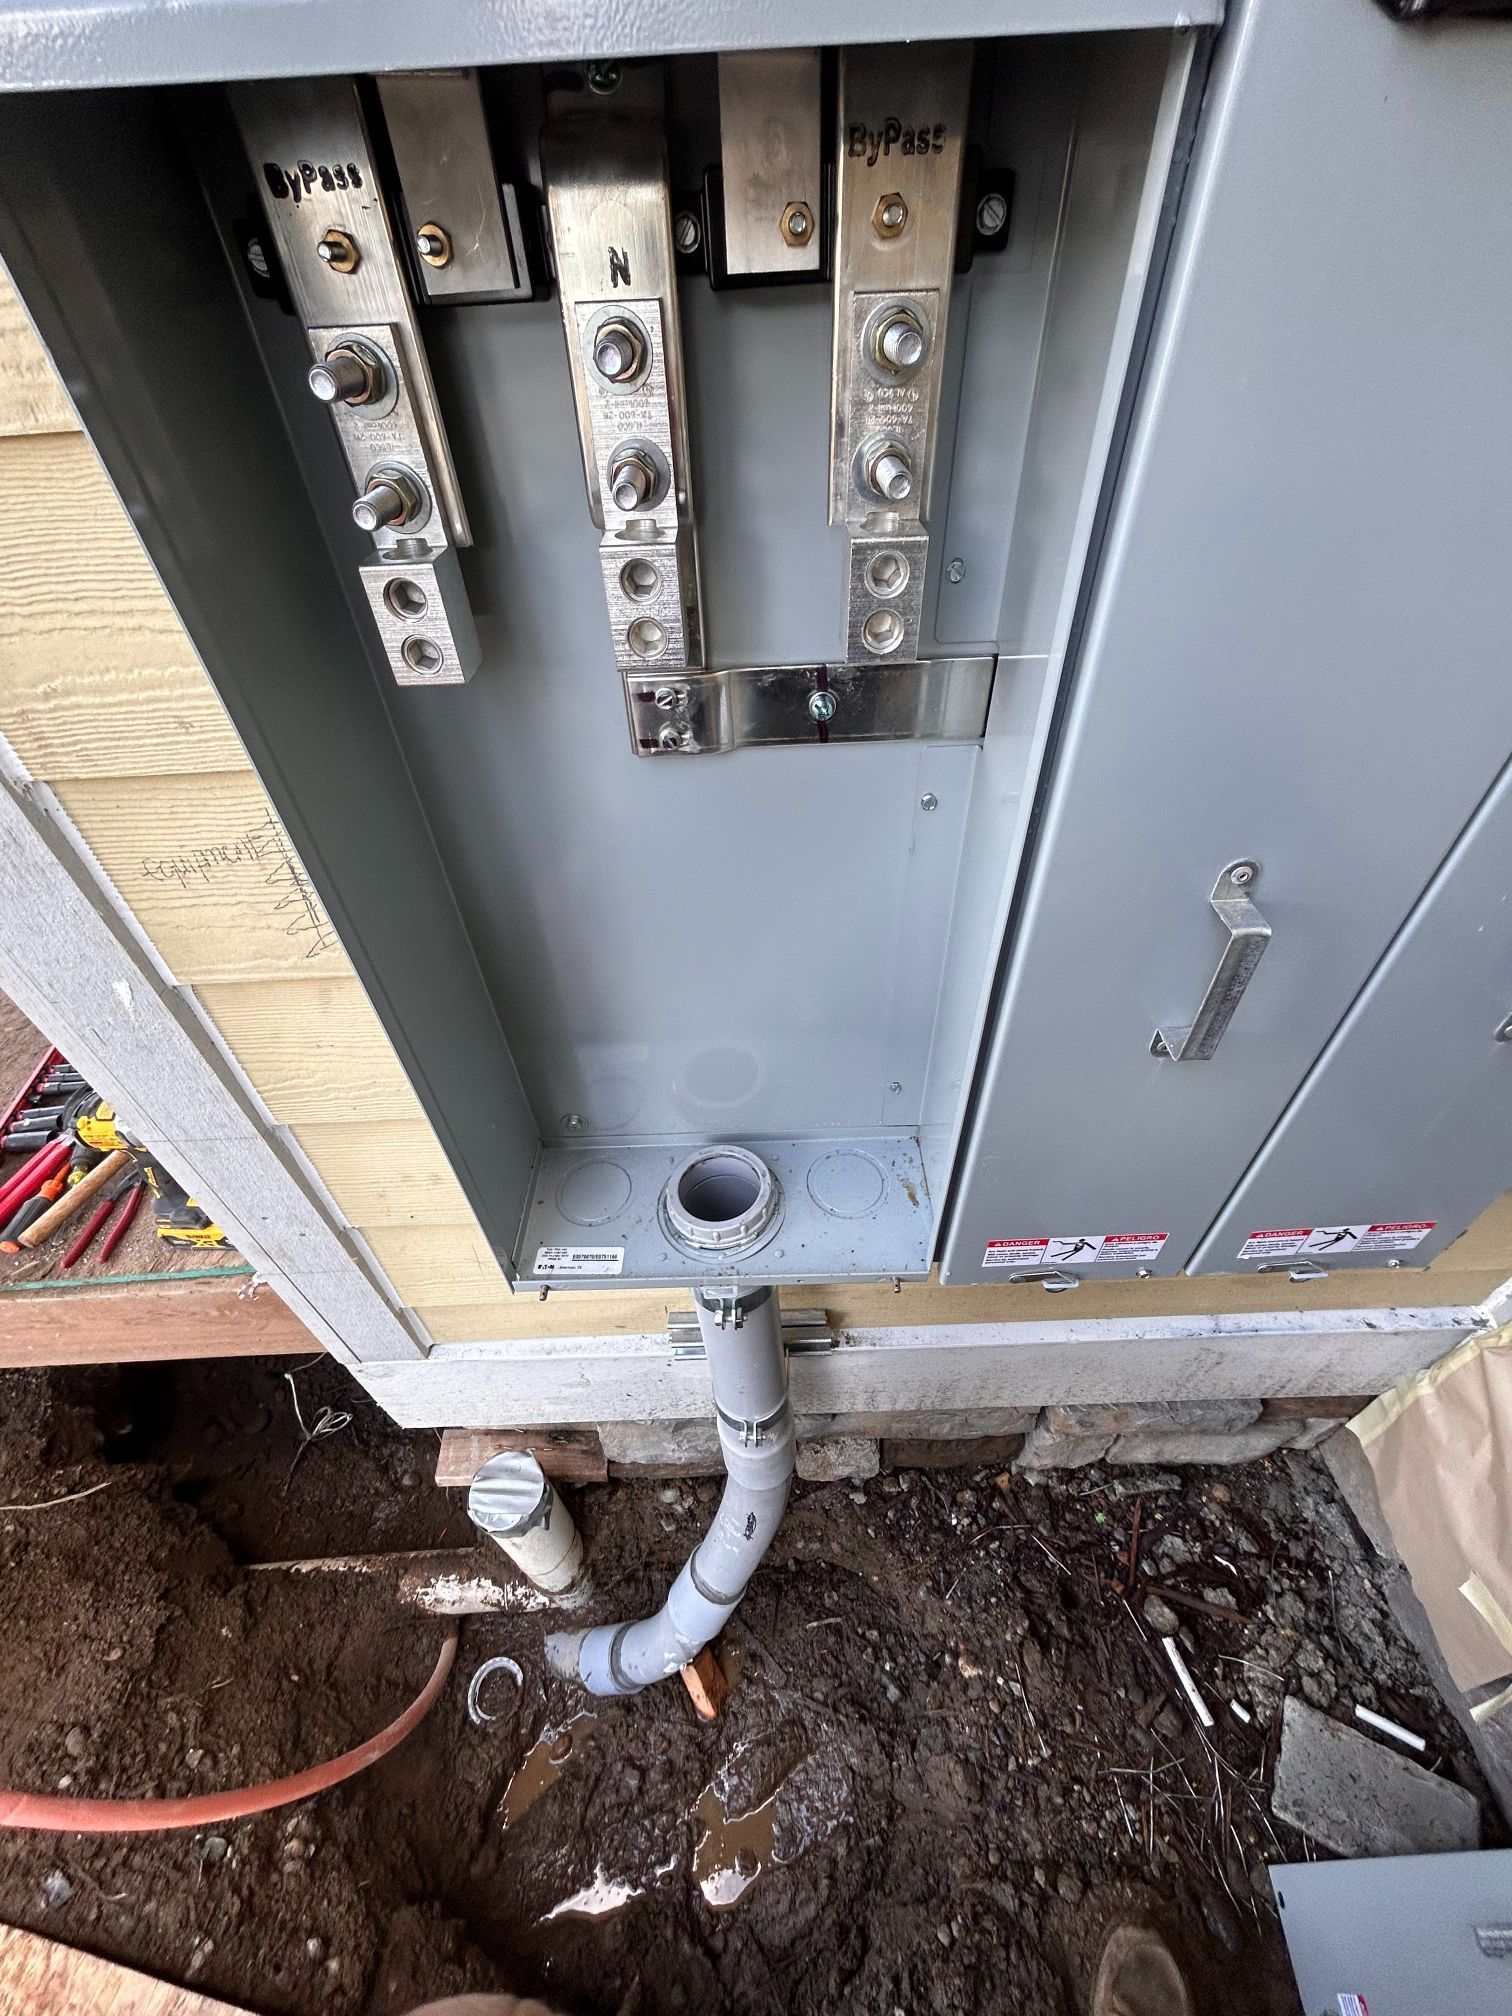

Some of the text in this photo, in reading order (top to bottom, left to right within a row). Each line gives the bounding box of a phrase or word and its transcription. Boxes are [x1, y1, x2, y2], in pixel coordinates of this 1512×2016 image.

[845, 117, 947, 168] ByPass
[263, 159, 363, 204] ByPass
[607, 246, 631, 288] N
[1264, 1230, 1304, 1238] DANGER
